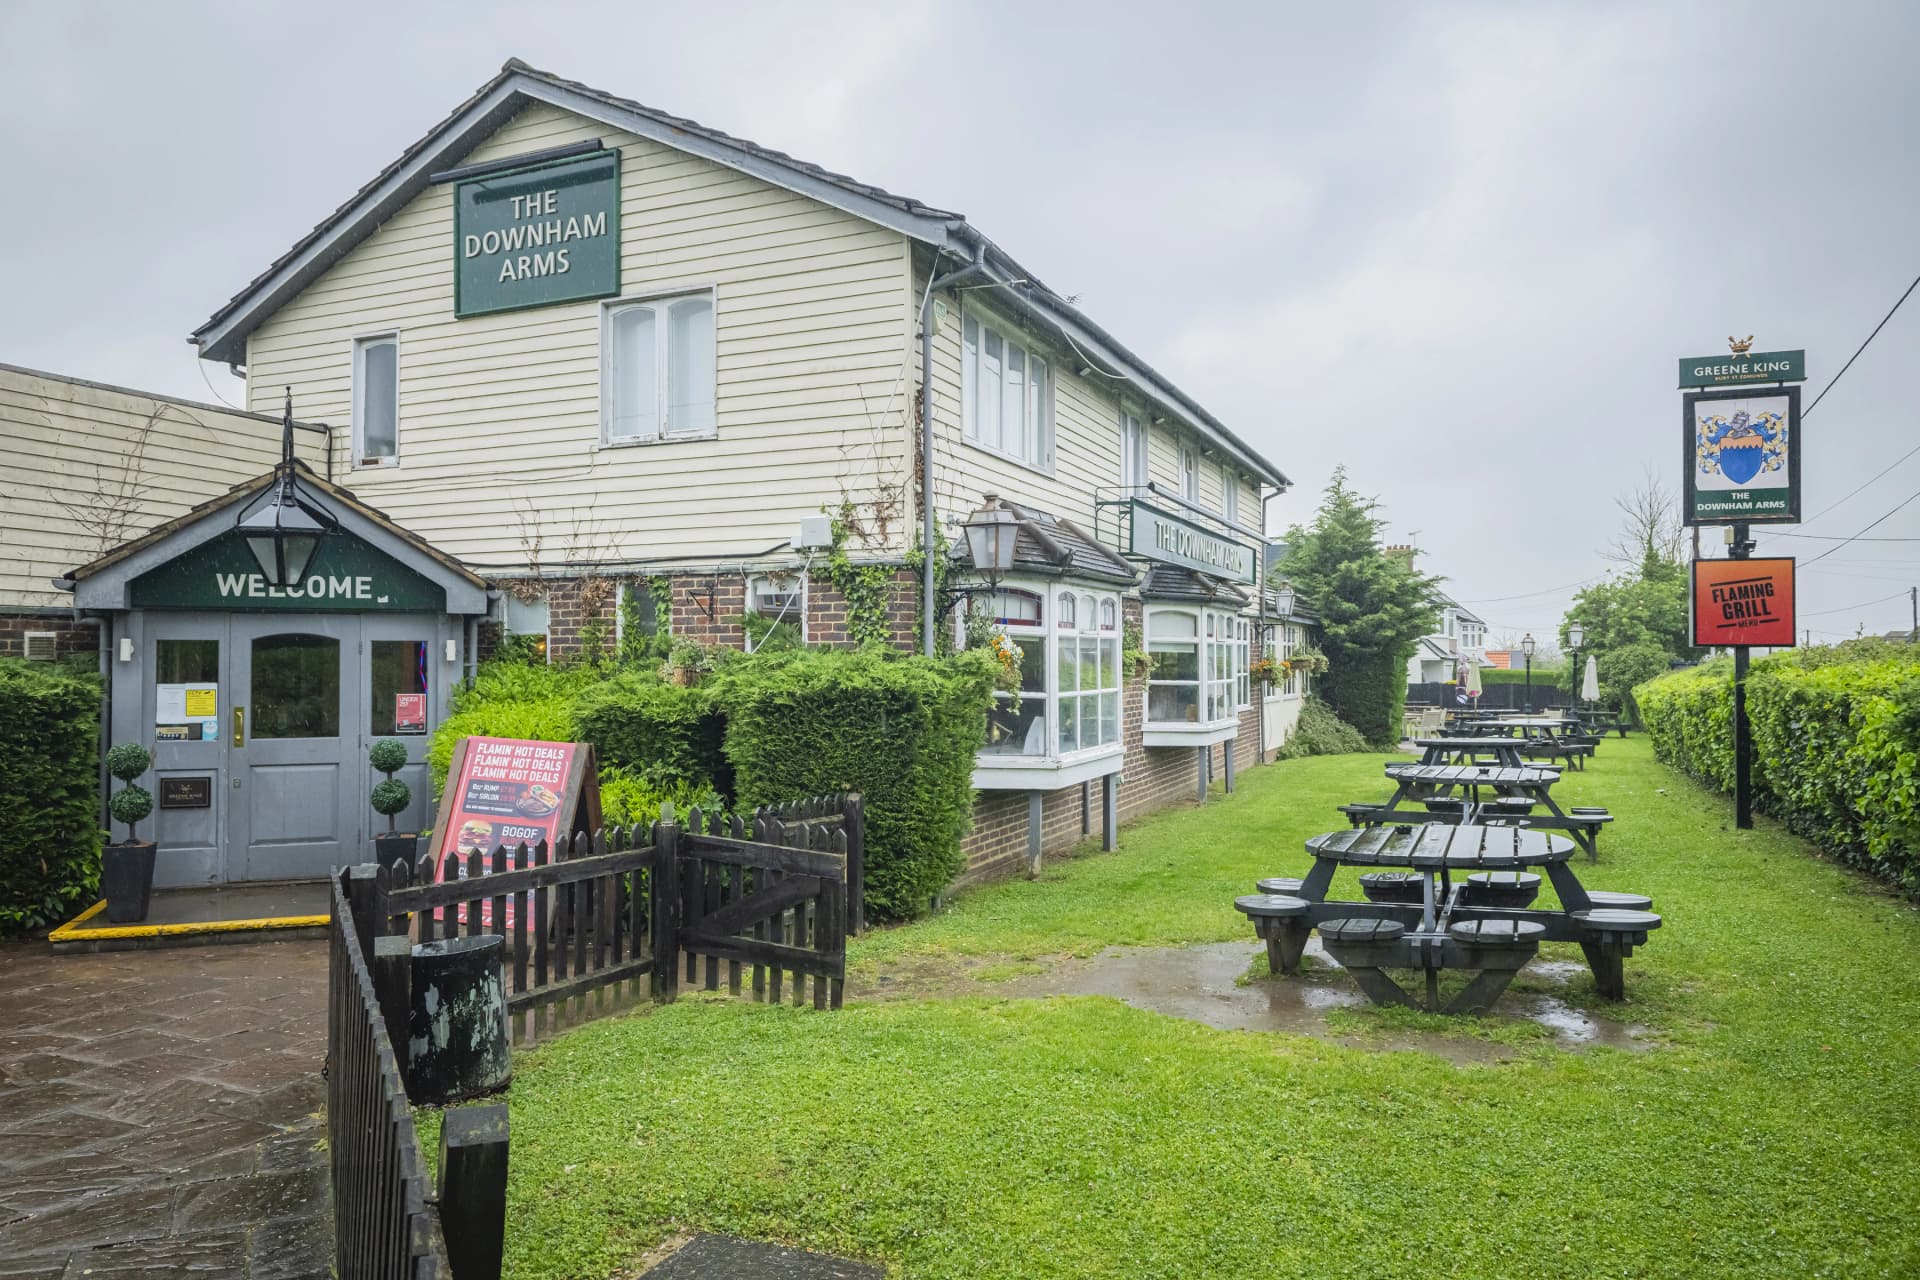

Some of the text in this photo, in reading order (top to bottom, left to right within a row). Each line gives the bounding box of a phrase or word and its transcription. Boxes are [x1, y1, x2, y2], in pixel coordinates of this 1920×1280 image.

[510, 190, 558, 219] THE
[465, 212, 607, 258] DOWNHAM
[499, 249, 570, 282] ARMS
[1694, 361, 1790, 376] GREENE KING
[1731, 492, 1750, 500] THE
[1697, 500, 1786, 511] DOWNHAM ARMS
[1154, 520, 1243, 574] THE DOWNHAM ARMS
[1711, 582, 1775, 603] FLAMING
[1722, 598, 1772, 620] GRILL
[477, 743, 565, 759] FLAMIN' HOT DEALS
[474, 754, 562, 771] FLAMIN' HOT DEALS
[471, 766, 560, 783] FLAMIN' HOT DEALS
[502, 826, 539, 839] BOGOF
